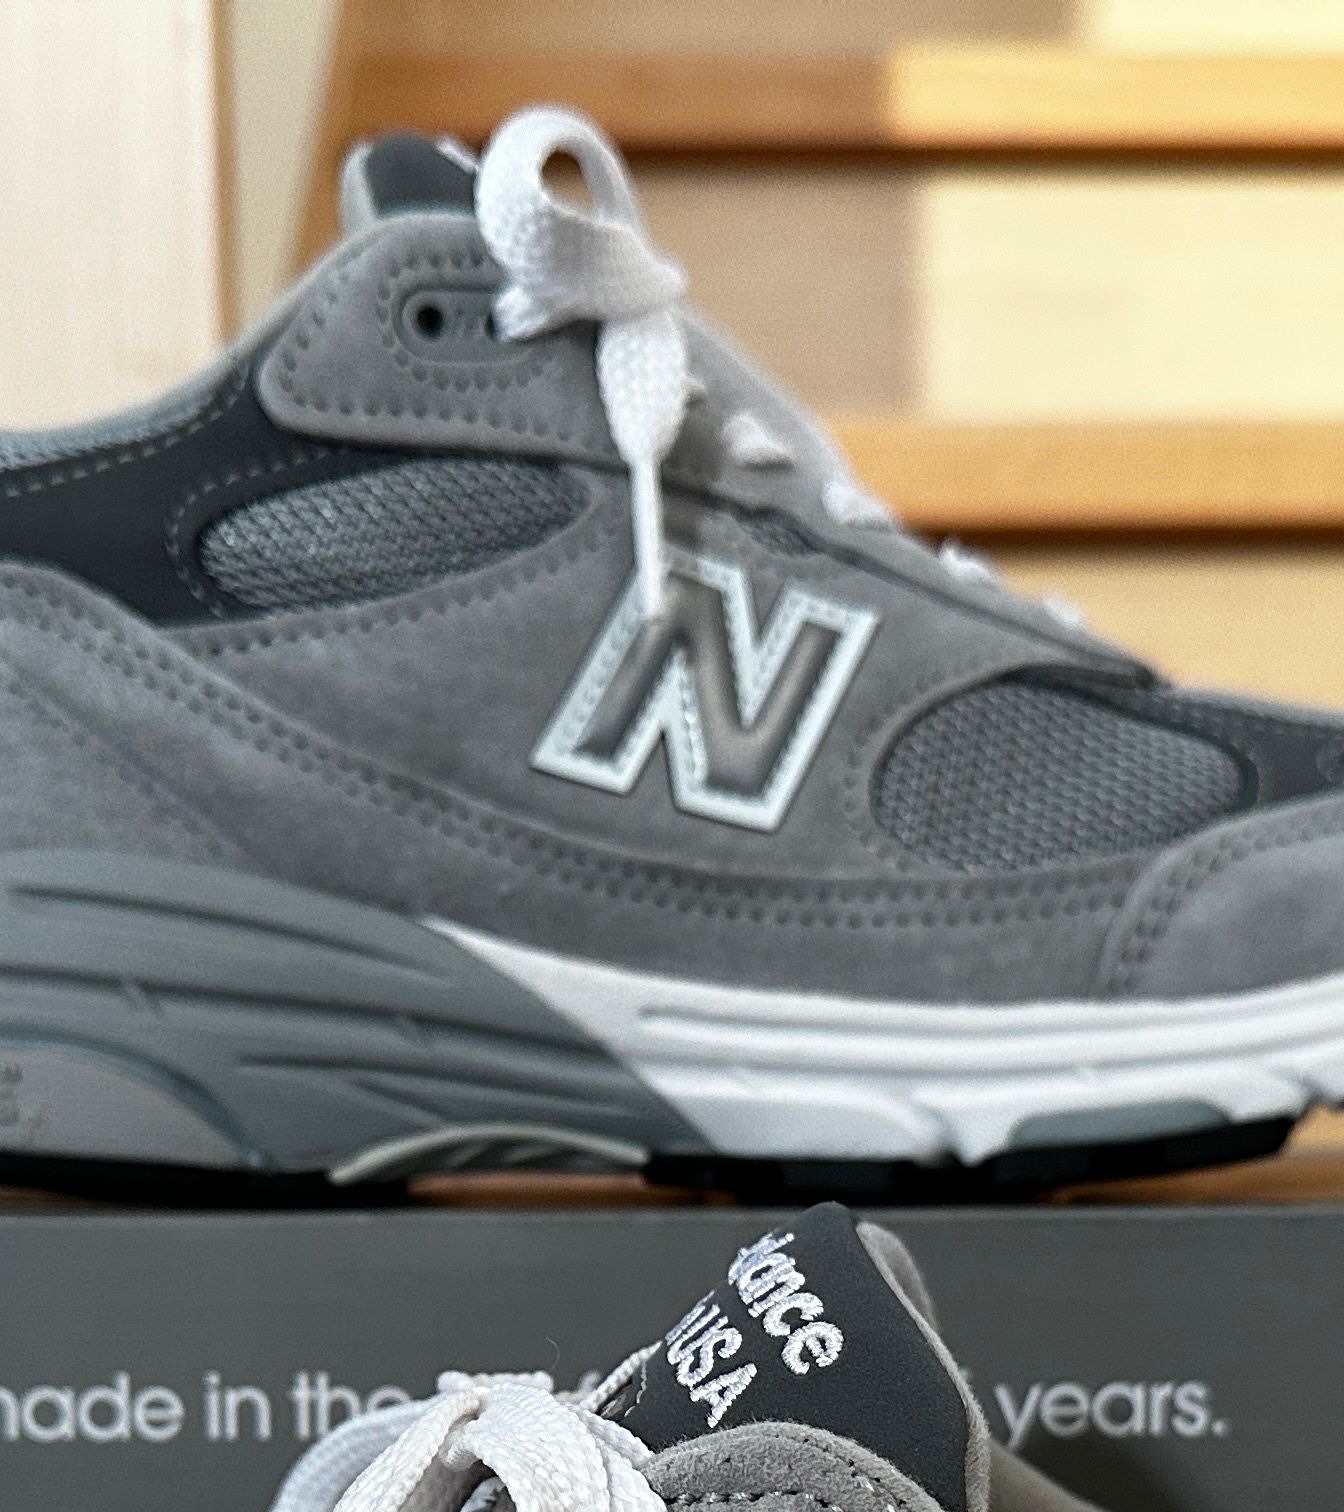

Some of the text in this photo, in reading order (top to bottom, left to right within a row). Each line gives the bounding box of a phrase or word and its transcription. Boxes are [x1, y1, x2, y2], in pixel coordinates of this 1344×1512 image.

[530, 548, 880, 832] N
[204, 1370, 272, 1442] in
[992, 1380, 1230, 1450] years.
[666, 1303, 757, 1429] USA
